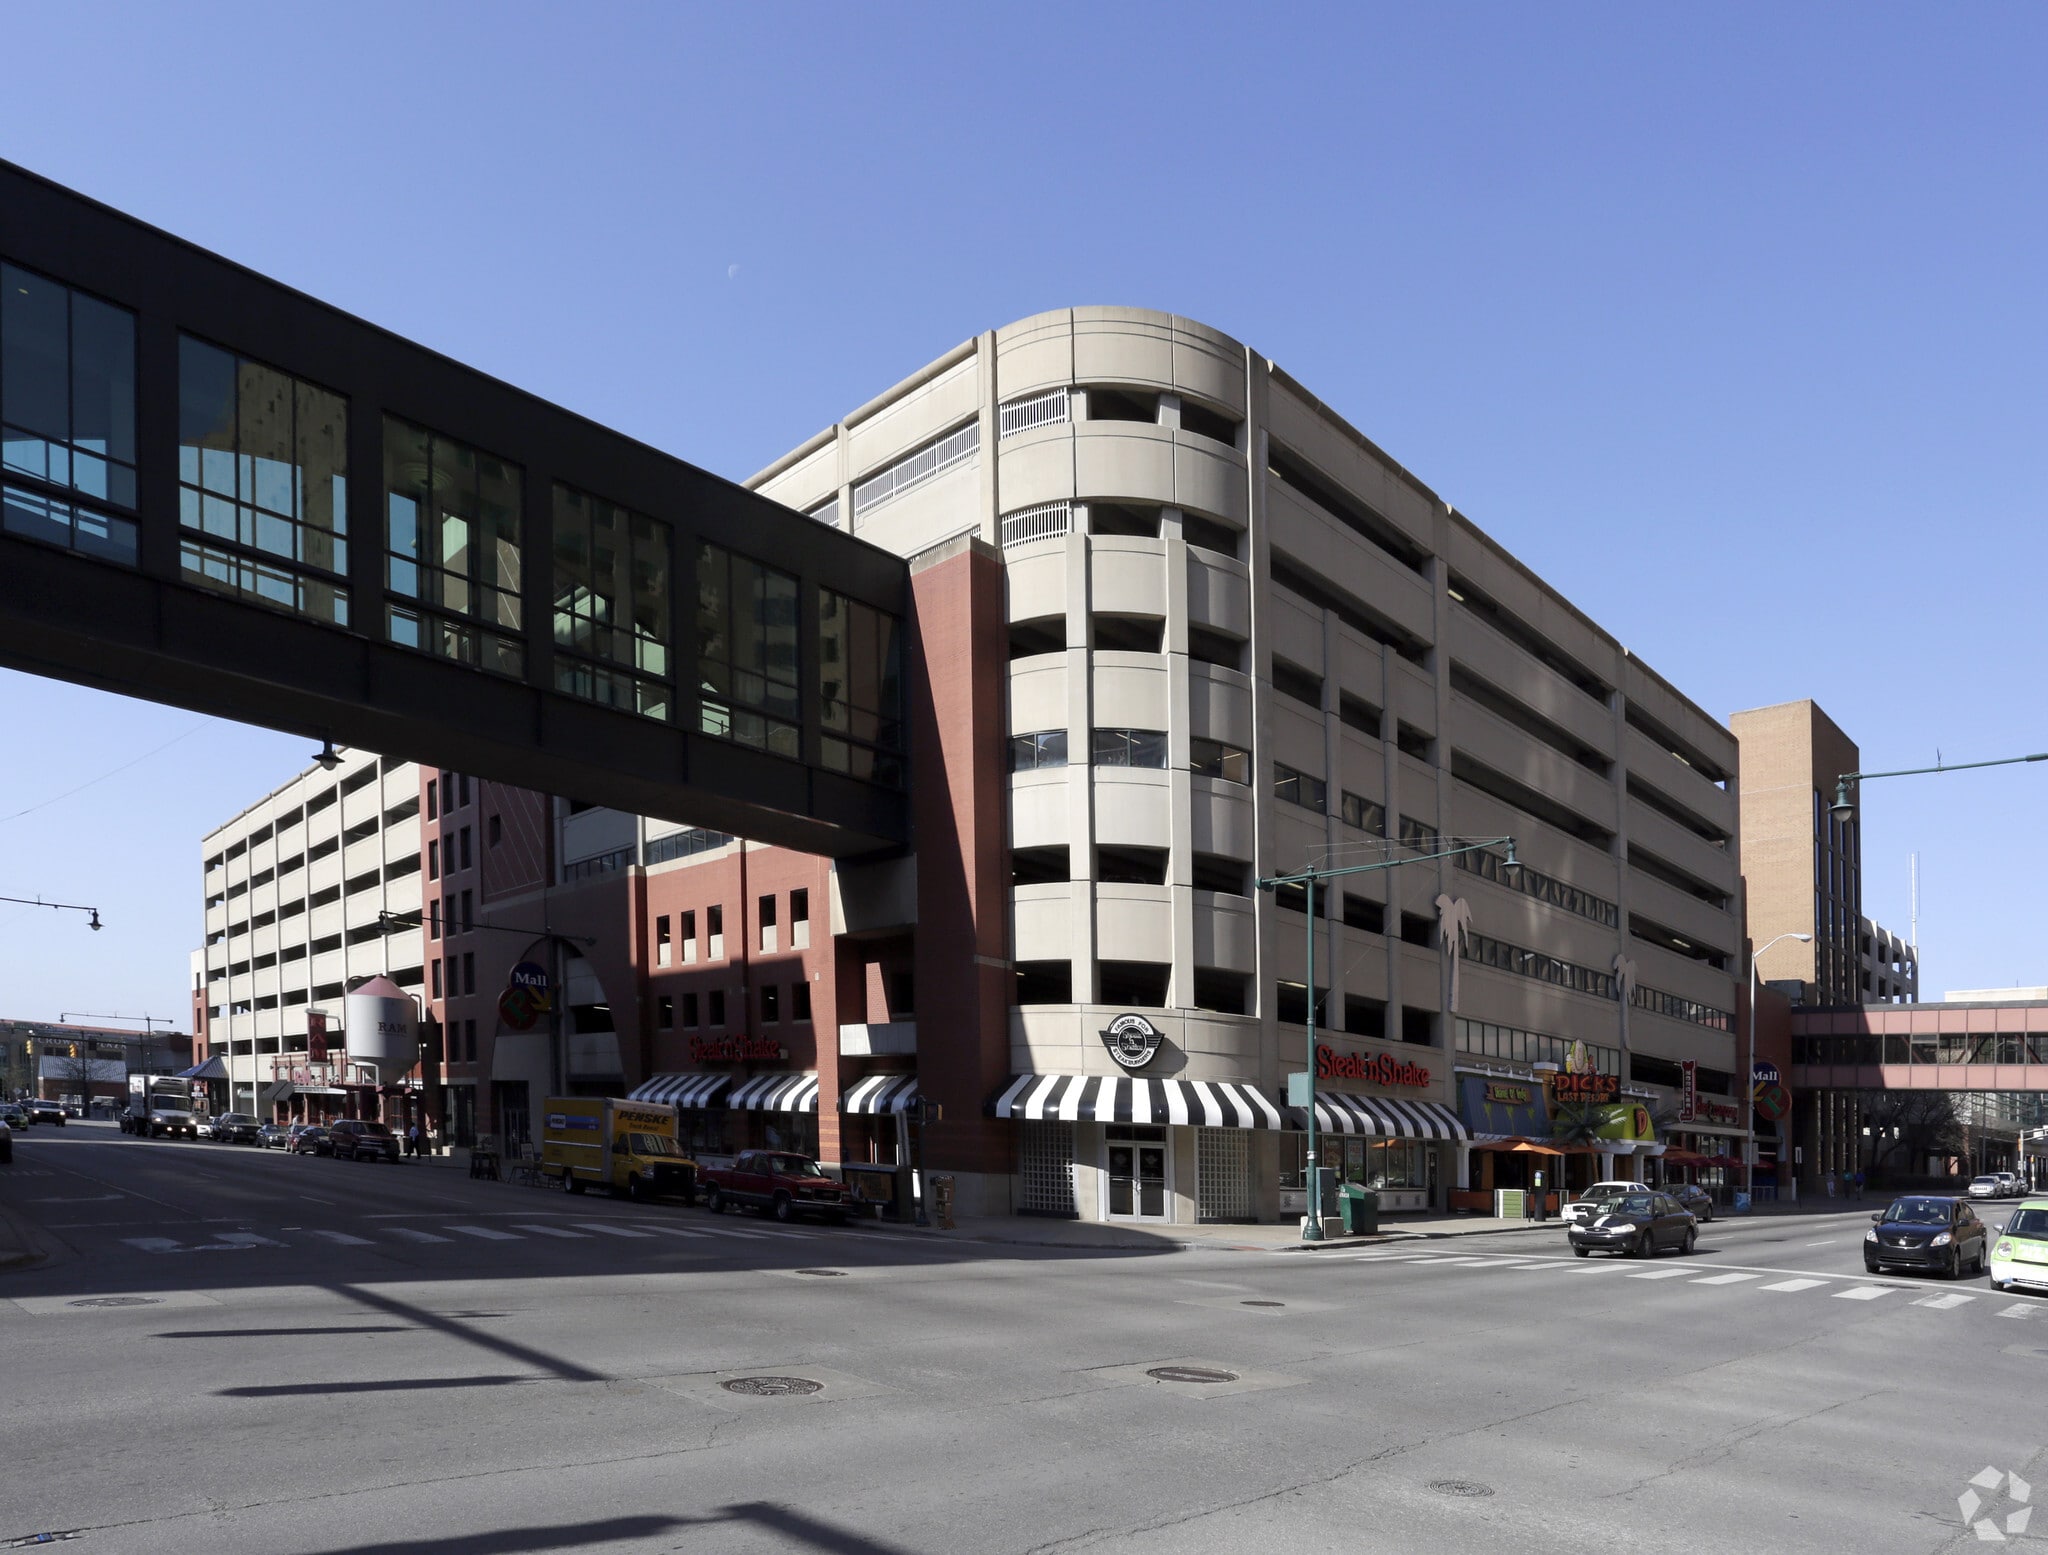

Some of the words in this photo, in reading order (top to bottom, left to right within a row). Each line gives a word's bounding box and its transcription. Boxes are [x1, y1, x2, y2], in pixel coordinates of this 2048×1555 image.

[515, 972, 547, 987] Mall
[378, 1021, 407, 1034] RAM
[1114, 1018, 1136, 1032] FAMOUS
[1138, 1021, 1150, 1033] FOR
[95, 1040, 127, 1050] LAZA
[1113, 1048, 1152, 1065] STEAKBURGERS
[1380, 1053, 1431, 1088] Shake
[1753, 1071, 1778, 1081] Mall
[1556, 1075, 1617, 1093] DICK'S
[1557, 1092, 1579, 1102] LAST
[618, 1110, 671, 1125] PENSKE
[1636, 1109, 1648, 1137] D
